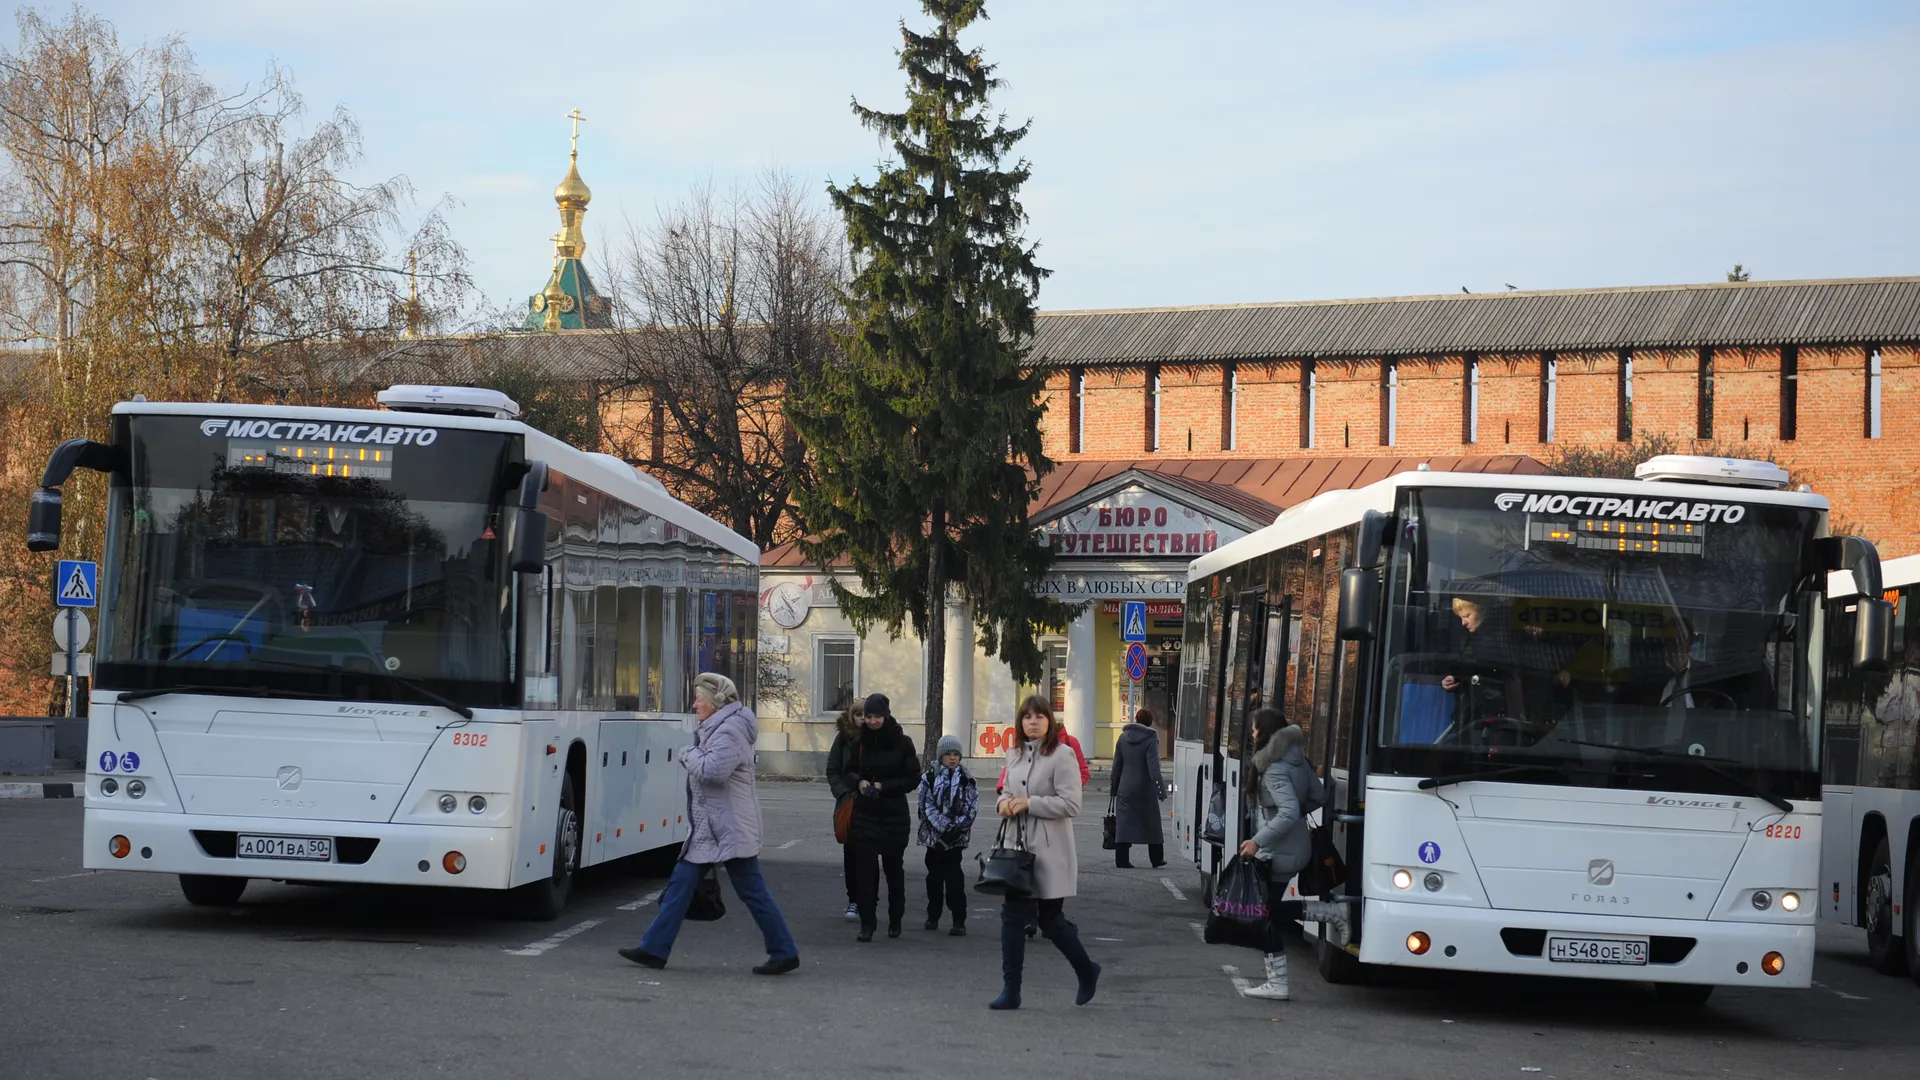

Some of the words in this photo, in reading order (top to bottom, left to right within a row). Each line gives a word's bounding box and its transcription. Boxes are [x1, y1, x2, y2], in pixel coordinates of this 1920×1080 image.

[226, 420, 437, 446] МОСТРАНСАВТО
[1522, 493, 1745, 523] МОСТРАНСАВТО
[1098, 506, 1168, 527] БЮРО
[1067, 580, 1076, 594] В
[1080, 580, 1148, 594] ЛЮБЫХ
[1151, 580, 1187, 594] СТР
[1162, 640, 1182, 650] ФО
[453, 732, 488, 747] 8302
[979, 726, 1016, 754] ФО
[1765, 824, 1801, 839] 8220
[309, 840, 325, 852] 50
[1571, 893, 1630, 905] ГОЛАЗ
[1625, 943, 1641, 956] 50
